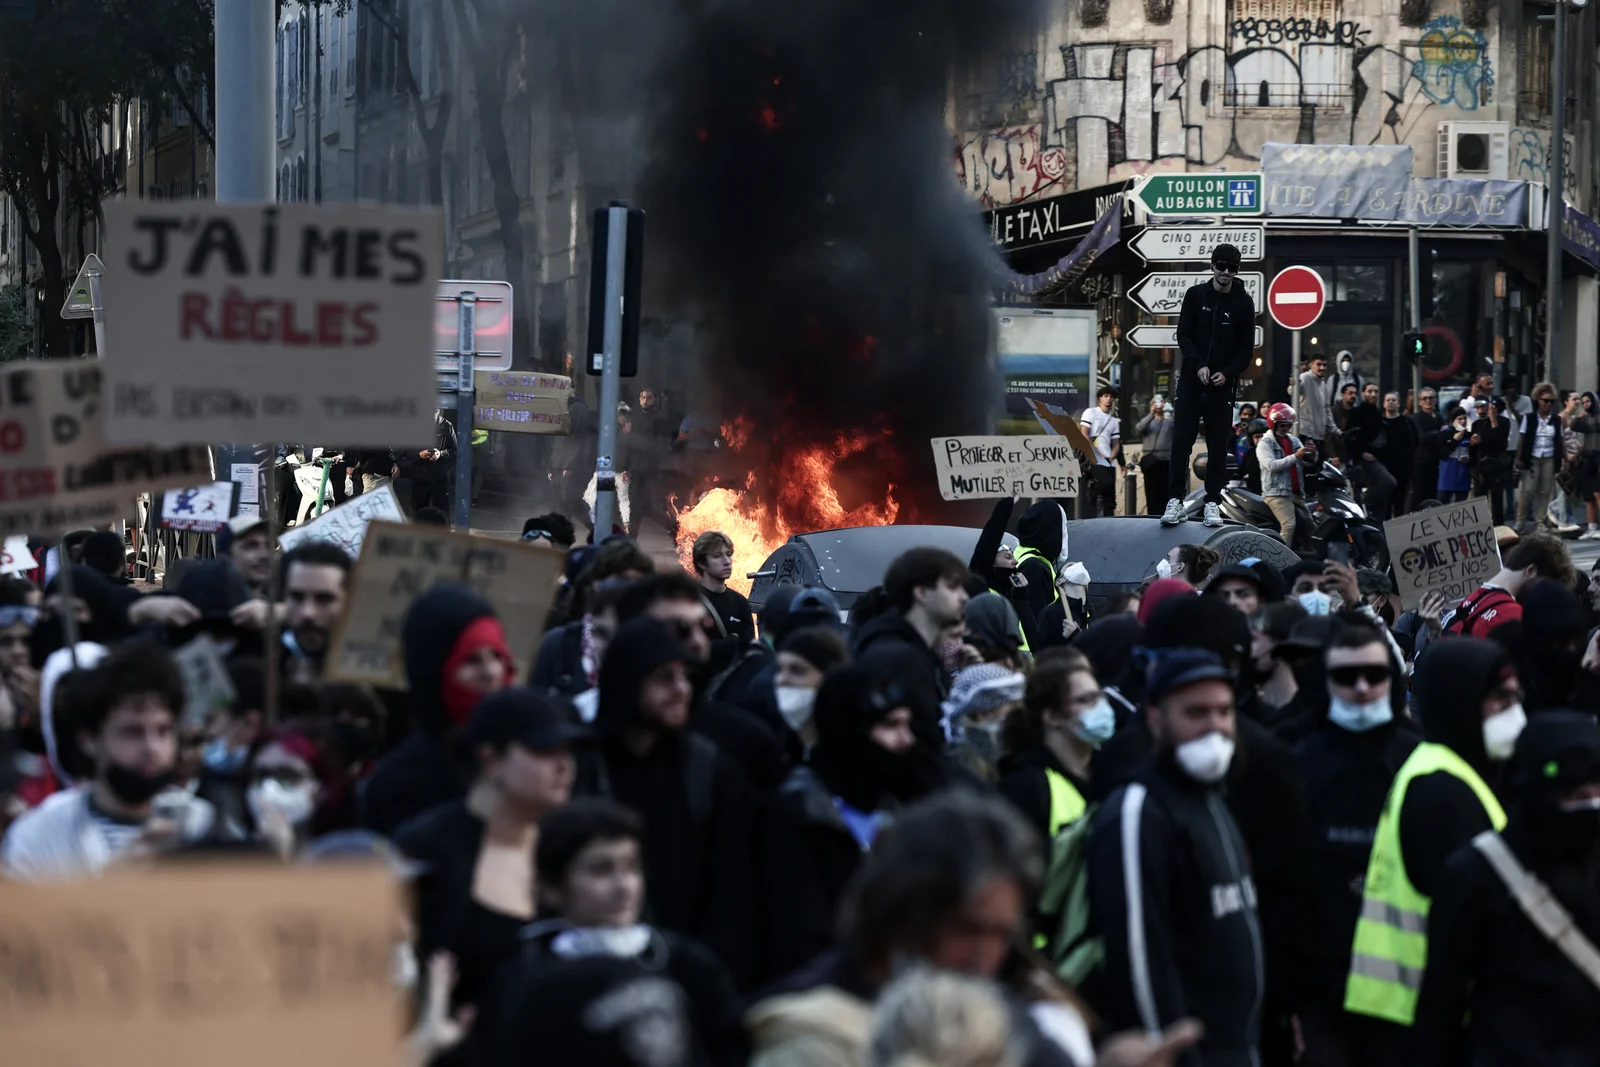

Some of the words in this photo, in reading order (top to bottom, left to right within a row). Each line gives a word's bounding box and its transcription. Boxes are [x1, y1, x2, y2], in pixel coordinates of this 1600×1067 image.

[1167, 180, 1225, 193] TOULON
[1156, 196, 1225, 209] AUBAGNE
[1368, 187, 1506, 217] SARDINE
[1017, 202, 1060, 241] TAXI
[1161, 233, 1192, 244] CINQ
[1200, 232, 1257, 243] AVENUES
[299, 223, 428, 287] MES
[1198, 244, 1256, 256] BABE
[1153, 277, 1187, 288] Palais
[489, 373, 517, 387] PLUS
[1008, 452, 1022, 463] ET
[1023, 438, 1072, 463] SERVIR
[1005, 467, 1023, 478] PAS
[950, 473, 1006, 495] MUTILER
[1013, 480, 1025, 493] ET
[1030, 473, 1077, 493] GAZER
[1410, 518, 1434, 541] LE
[1438, 505, 1479, 531] VRAI
[1413, 564, 1457, 588] C'EST
[1461, 557, 1490, 577] NOS
